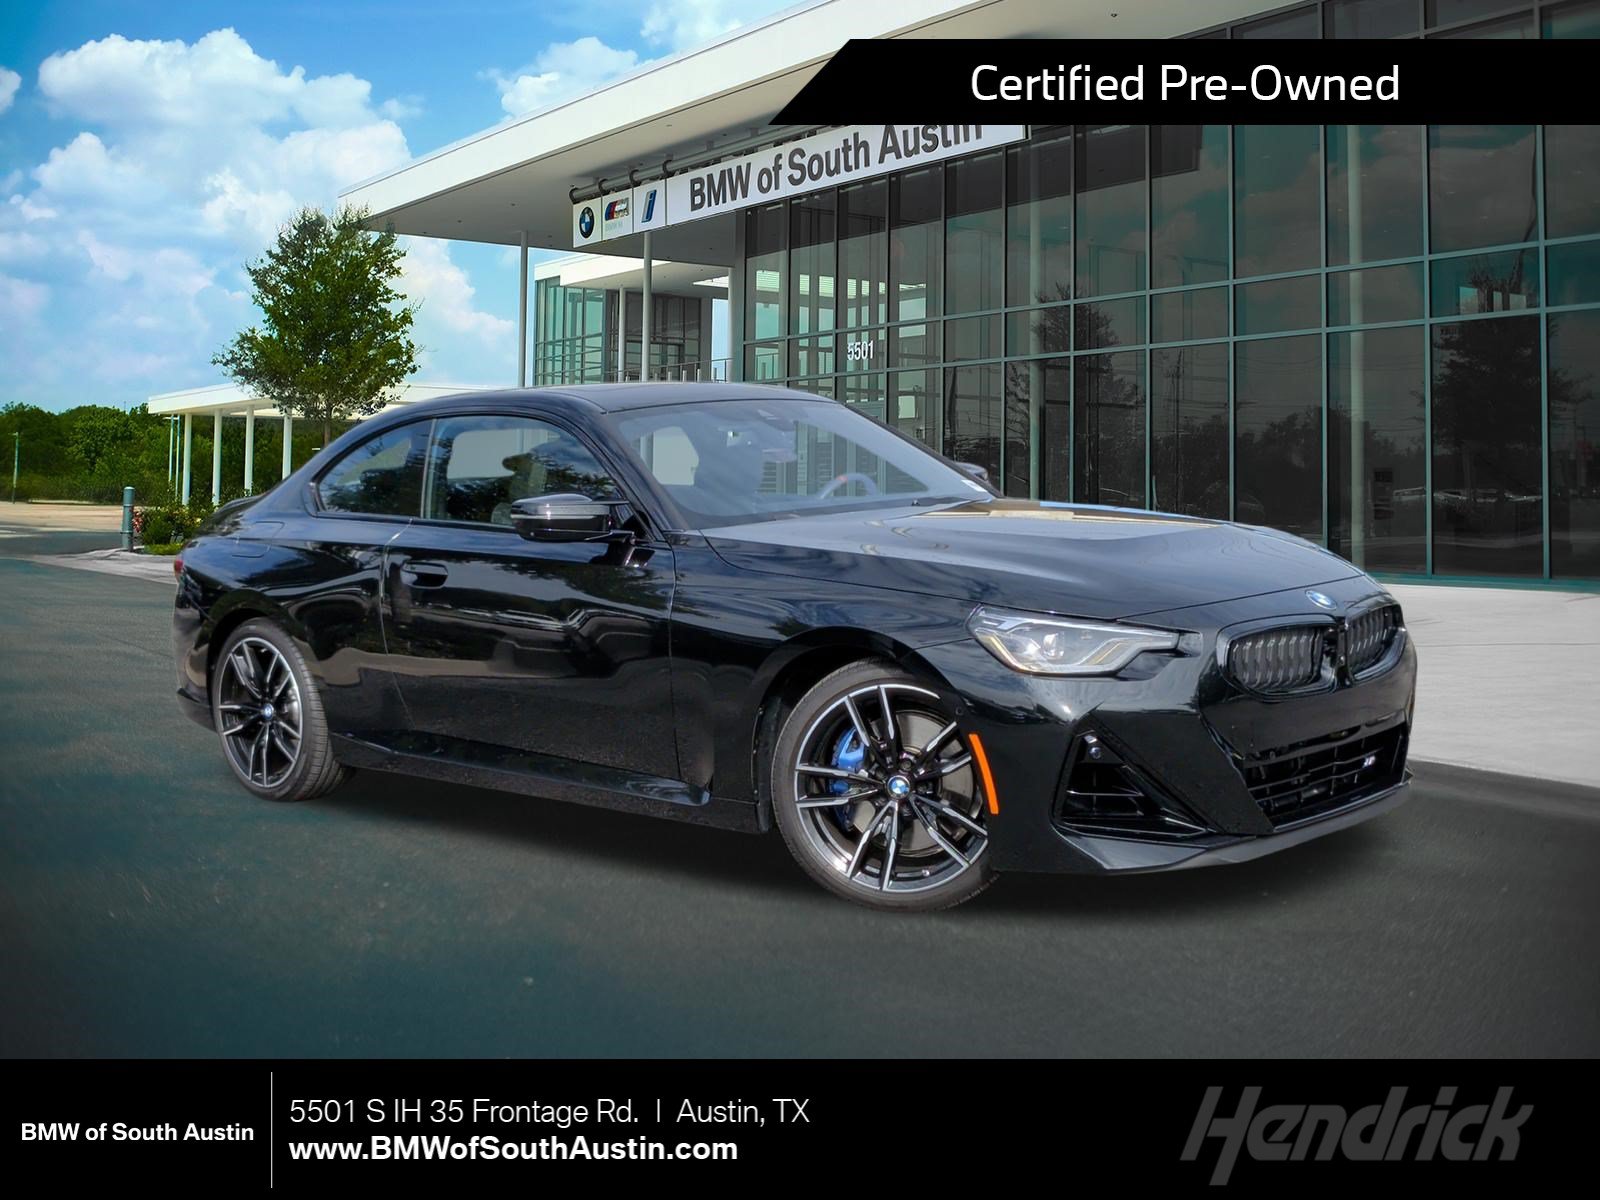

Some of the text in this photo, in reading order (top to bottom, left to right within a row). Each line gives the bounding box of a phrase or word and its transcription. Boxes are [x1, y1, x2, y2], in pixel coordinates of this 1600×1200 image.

[690, 162, 752, 212] BMW
[757, 153, 783, 194] of
[787, 132, 870, 186] South
[847, 340, 874, 361] 5501
